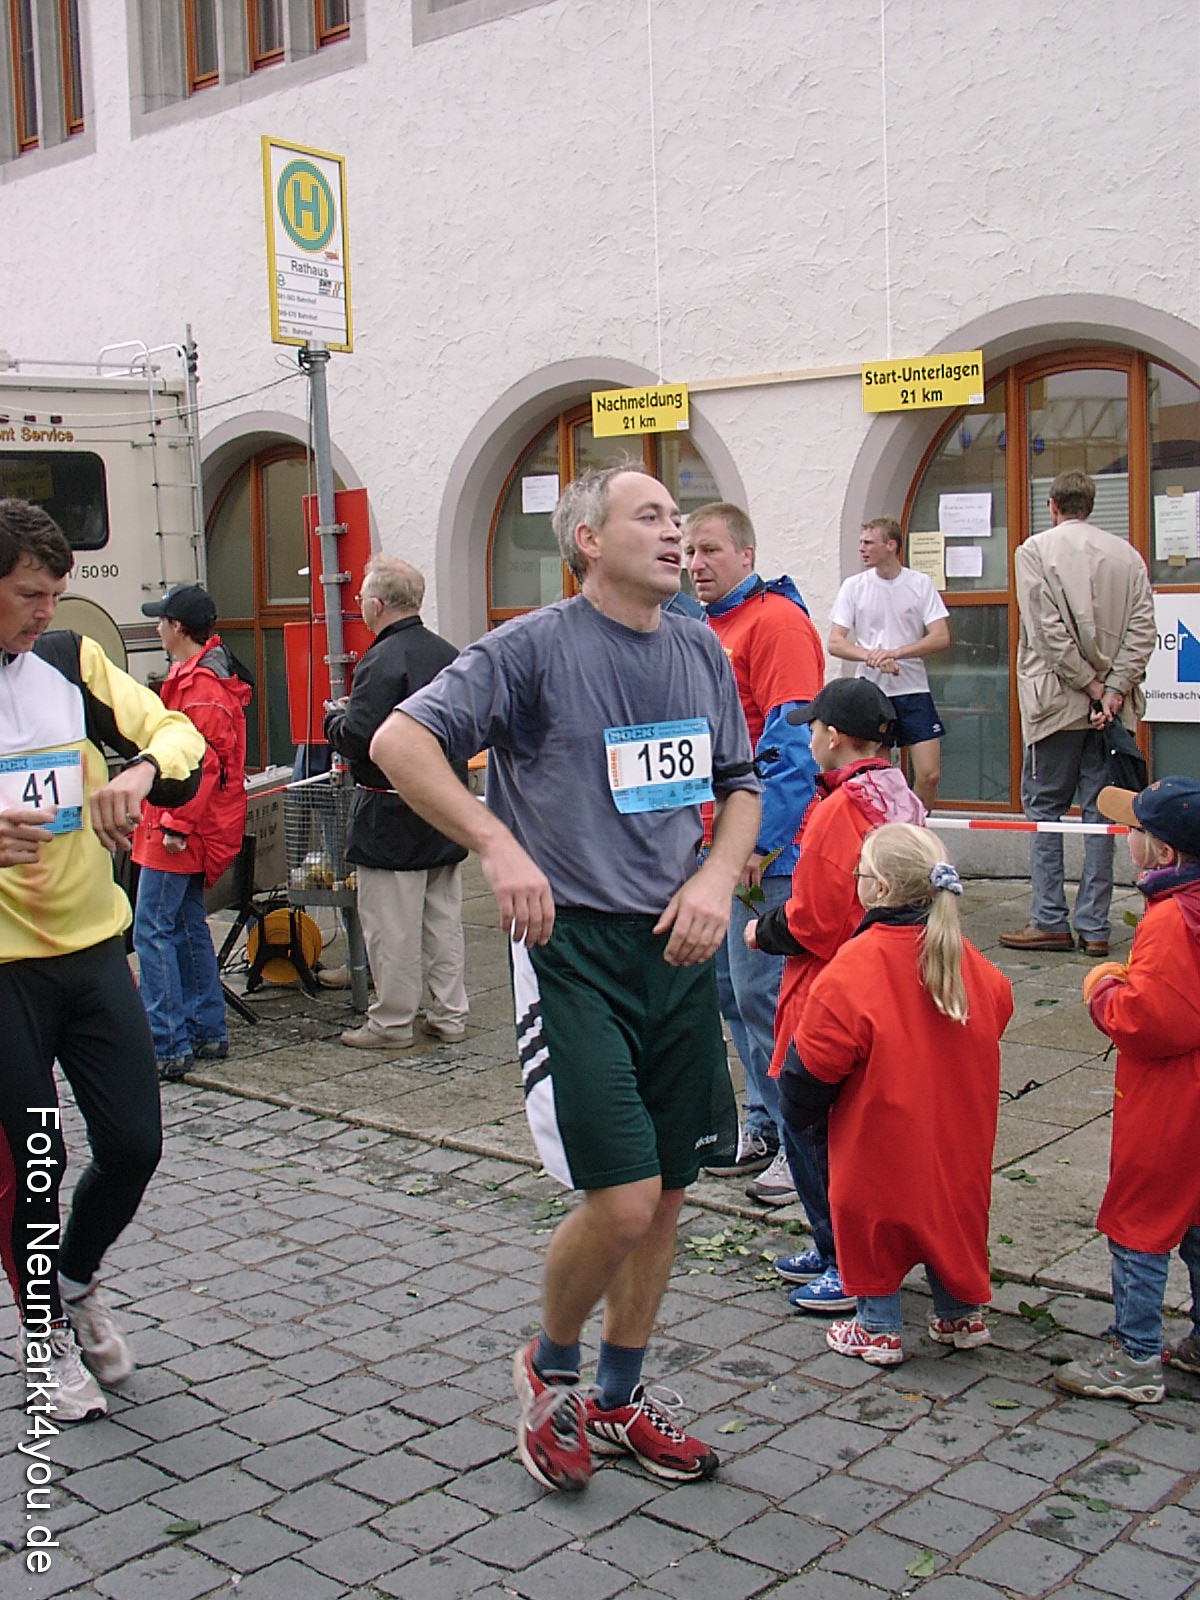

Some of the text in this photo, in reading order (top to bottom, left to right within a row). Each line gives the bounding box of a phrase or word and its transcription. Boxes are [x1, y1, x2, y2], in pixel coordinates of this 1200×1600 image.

[292, 180, 320, 232] H
[291, 260, 329, 277] Rathaus
[865, 363, 980, 386] Start-Unterlagen
[597, 392, 683, 413] Nachmeldung
[900, 387, 943, 404] 21 km
[623, 414, 656, 429] 21 km
[0, 426, 74, 442] nt Service
[638, 739, 694, 782] 158
[22, 769, 60, 808] 41
